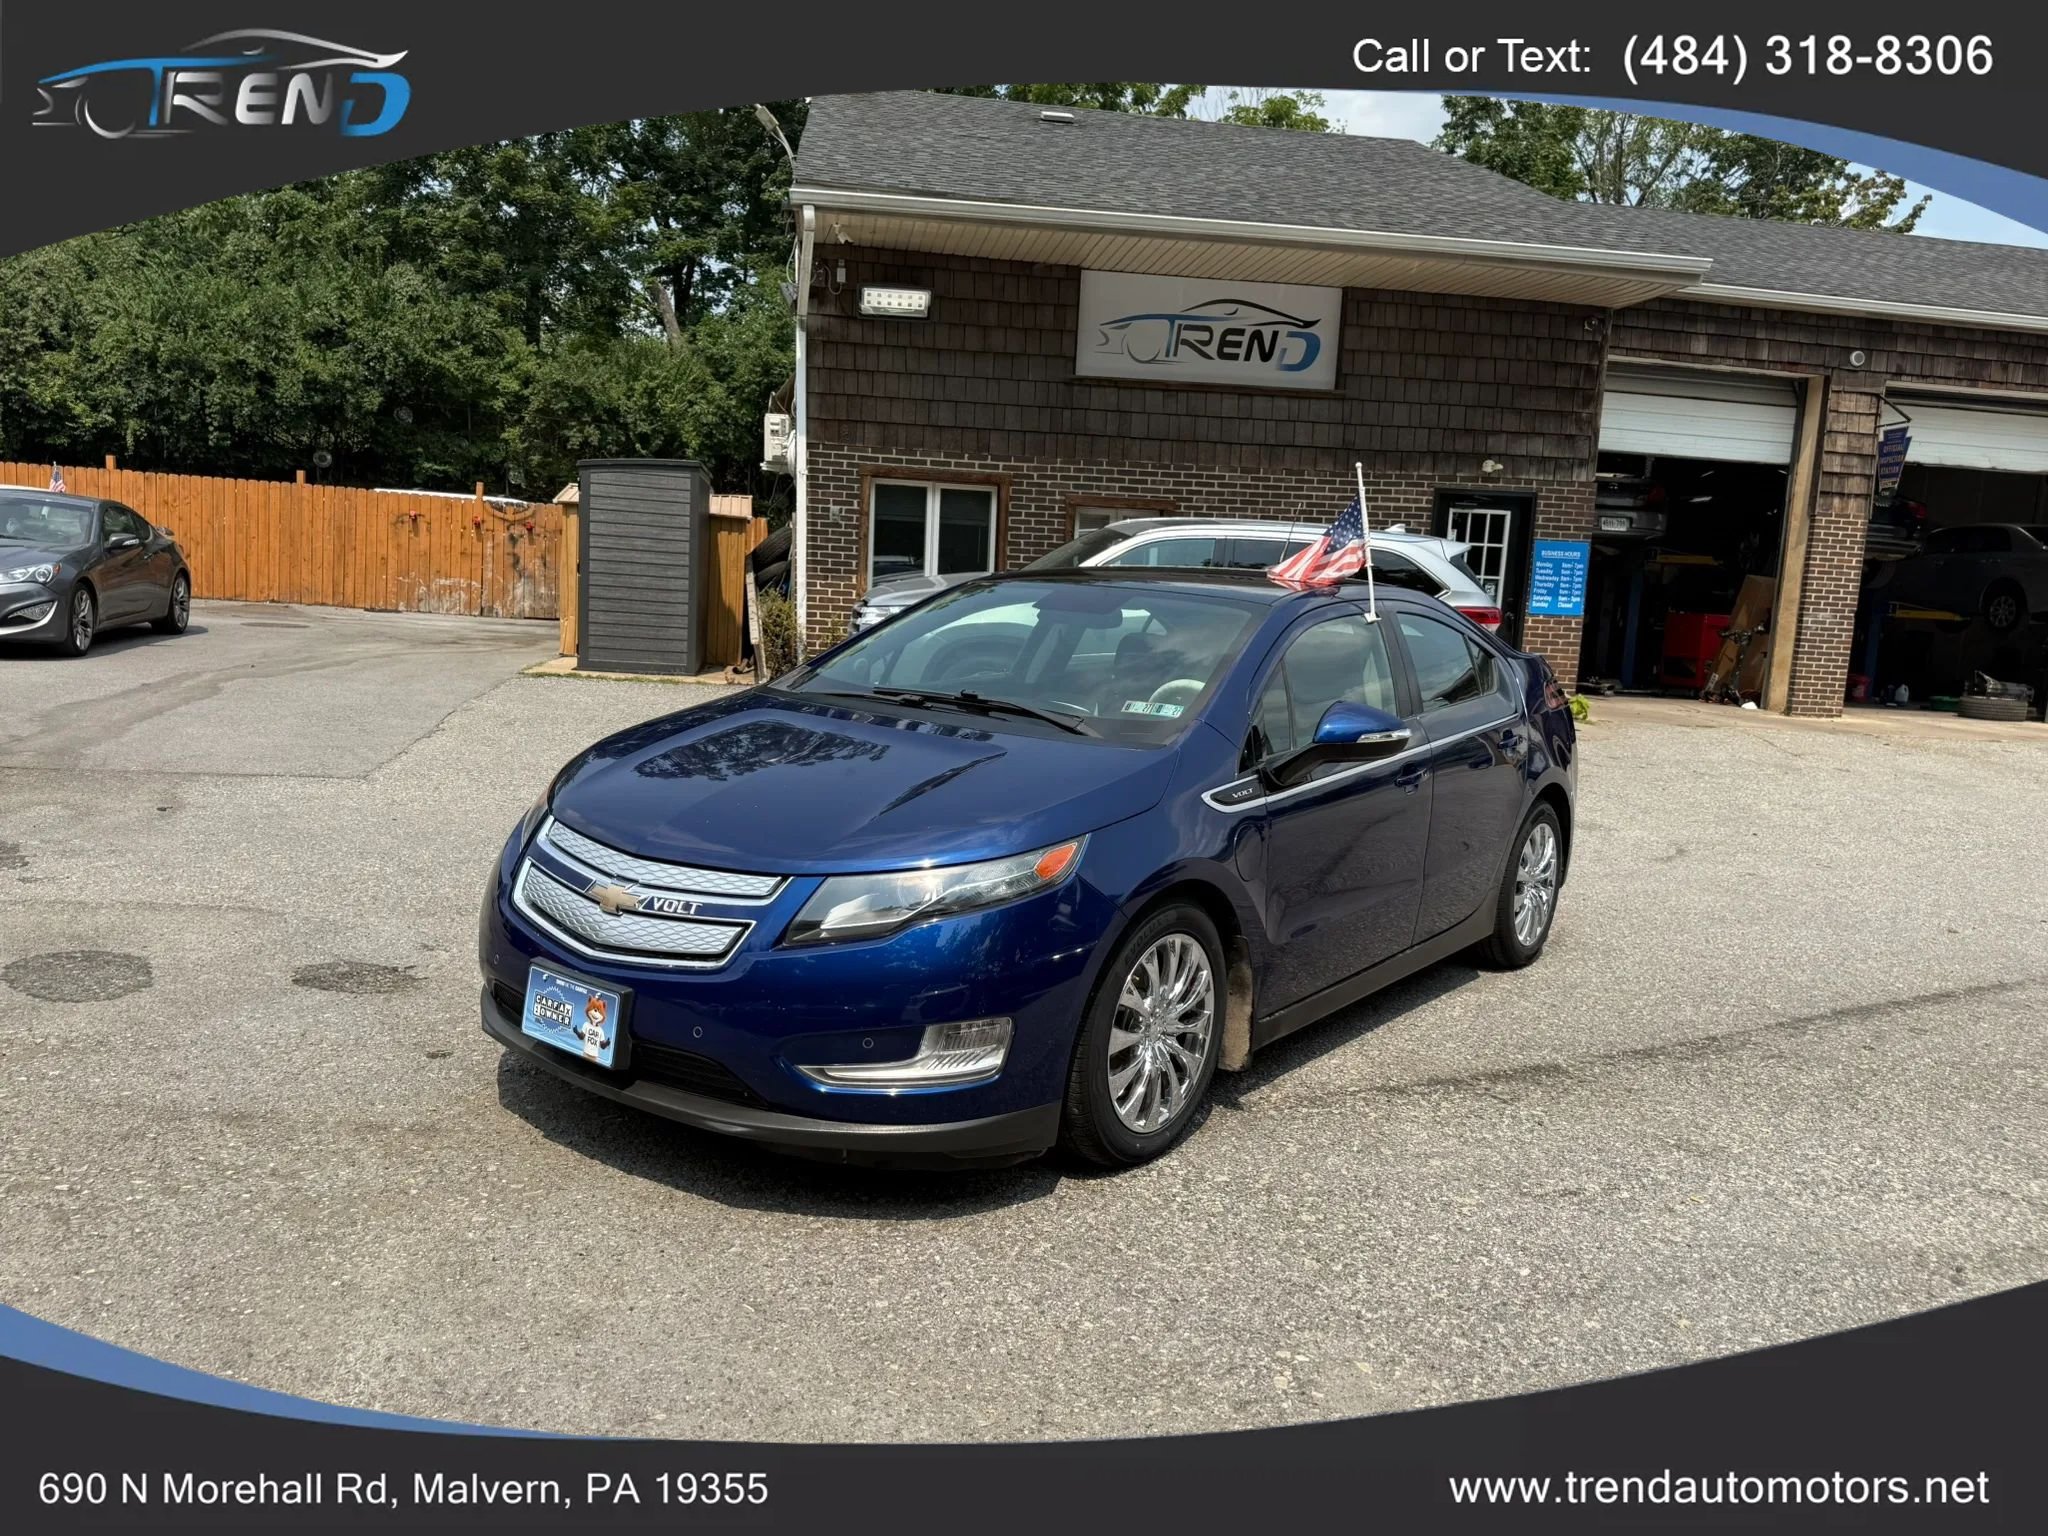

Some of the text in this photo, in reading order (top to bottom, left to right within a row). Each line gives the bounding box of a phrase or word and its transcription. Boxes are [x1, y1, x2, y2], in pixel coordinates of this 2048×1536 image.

[1152, 314, 1321, 372] TREND
[1232, 788, 1254, 798] VOLT
[652, 897, 703, 915] VOLT
[536, 994, 571, 1017] CARFAX
[540, 1008, 570, 1026] OWNER
[587, 1036, 598, 1048] FOX
[588, 1028, 600, 1039] CAR
